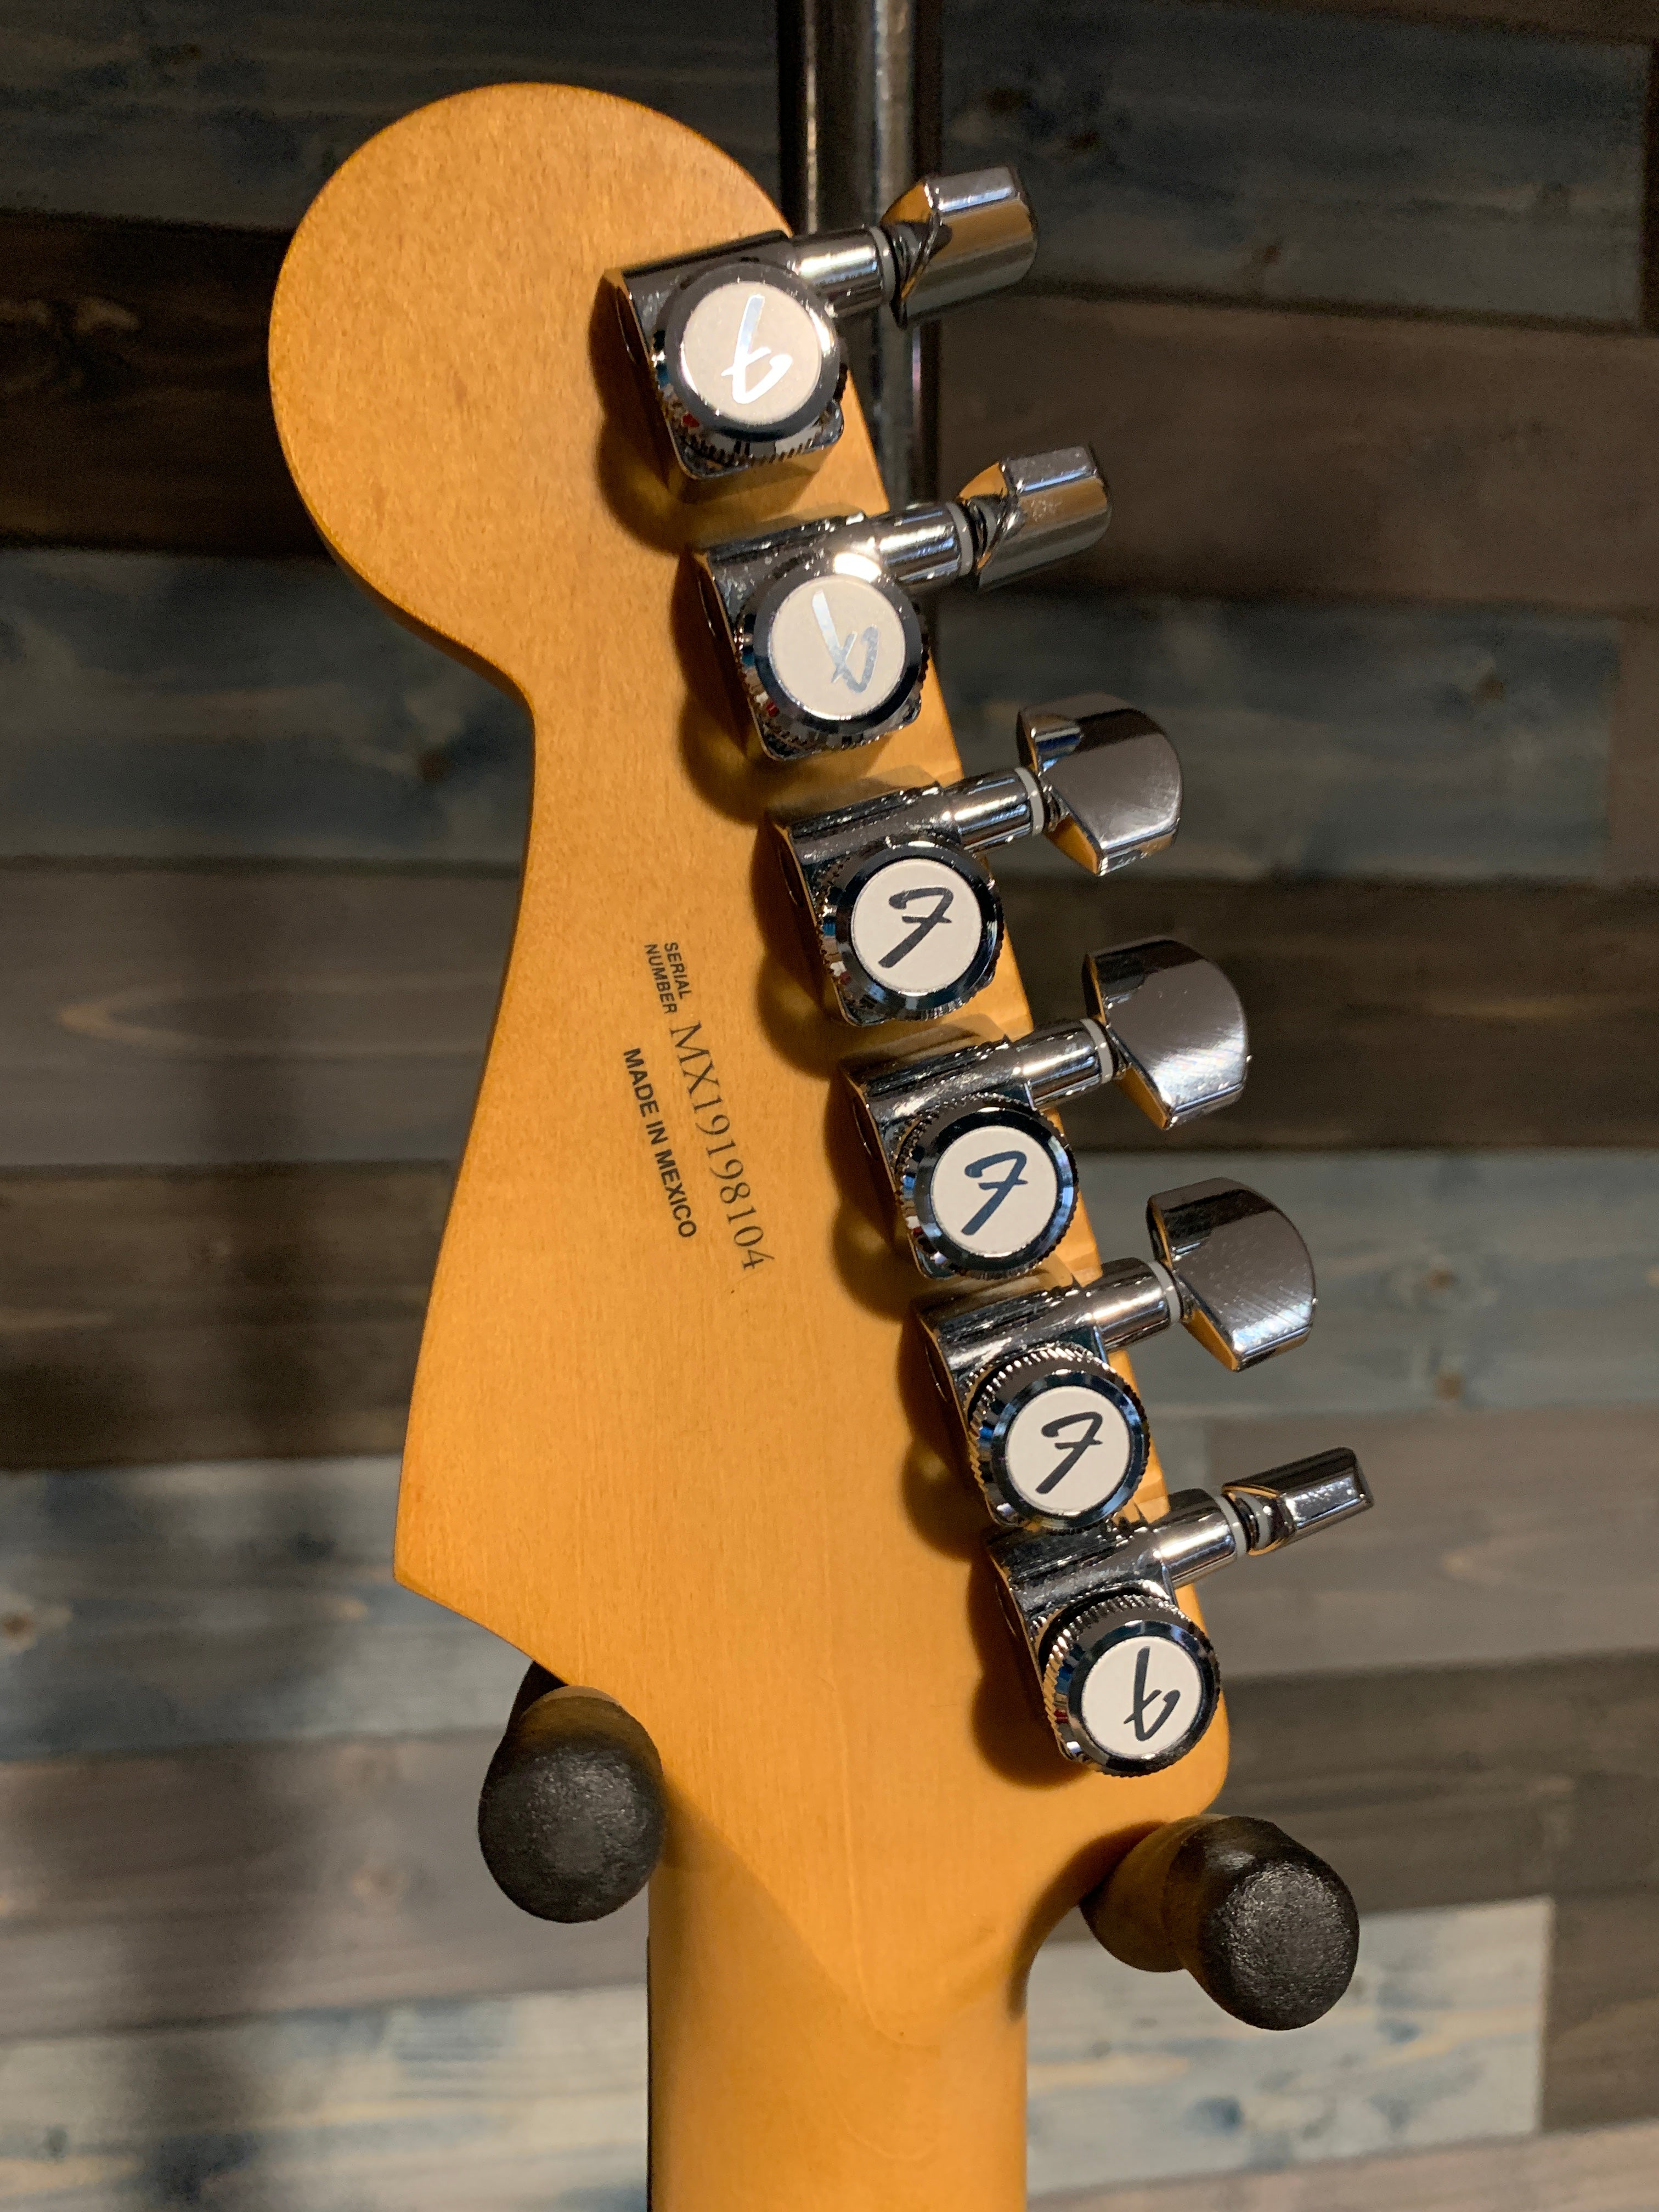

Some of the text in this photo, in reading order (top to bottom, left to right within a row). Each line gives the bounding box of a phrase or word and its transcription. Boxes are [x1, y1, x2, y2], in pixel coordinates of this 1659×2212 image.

[644, 943, 678, 1014] NUMBER
[664, 941, 692, 1000] SERIAL
[623, 1047, 697, 1238] MADE IN MEXICO
[669, 1020, 775, 1271] MX19198104
